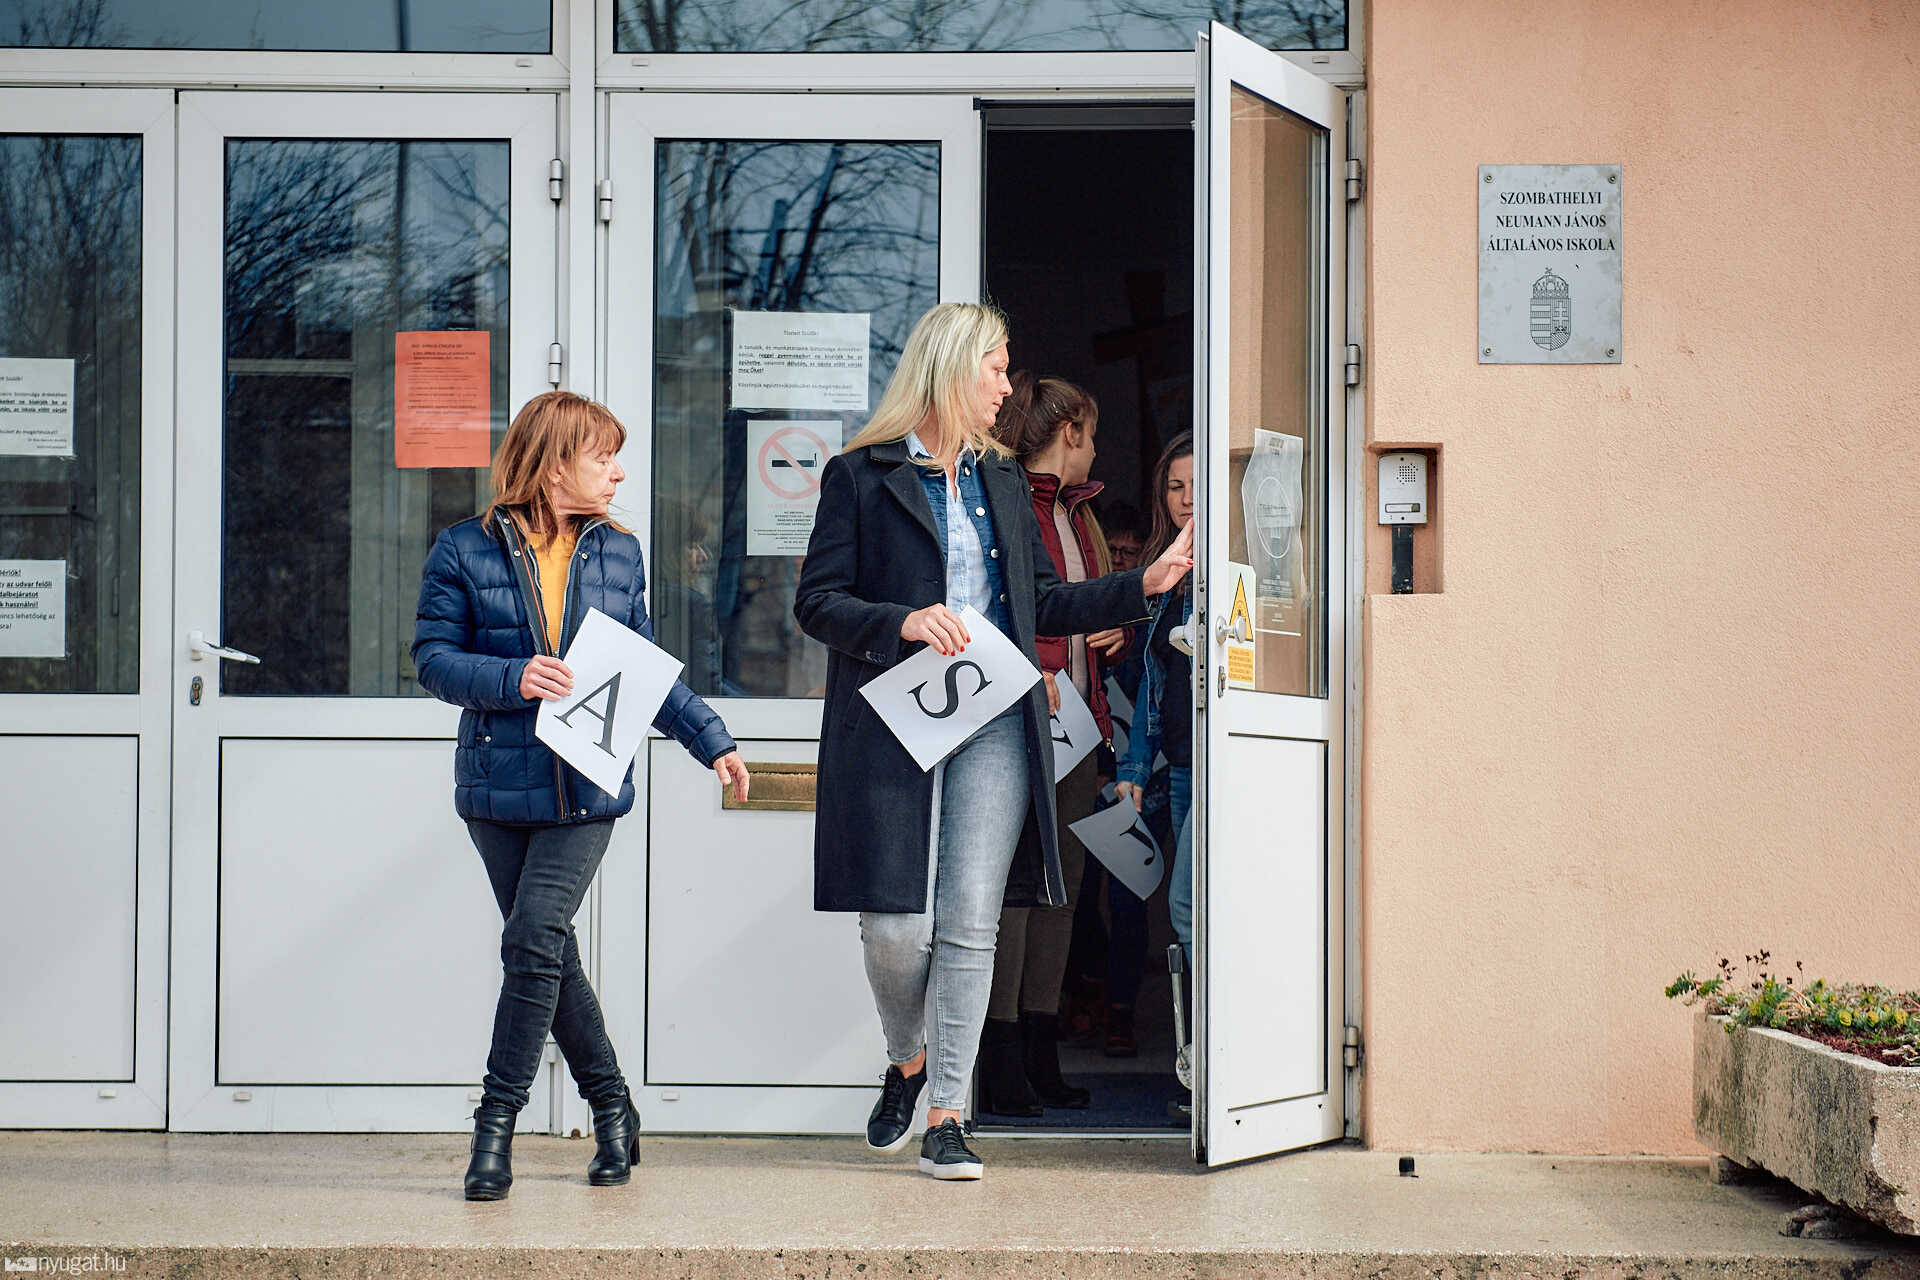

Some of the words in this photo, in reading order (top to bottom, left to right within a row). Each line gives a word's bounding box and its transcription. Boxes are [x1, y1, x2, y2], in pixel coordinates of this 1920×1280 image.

[1500, 191, 1601, 205] SZOMBATHELYI
[1496, 215, 1561, 228] NEUMANN
[1564, 211, 1607, 228] JÁNOS
[1487, 234, 1563, 251] ÁLTALÁNOS
[1567, 238, 1616, 251] ISKOLA
[907, 659, 993, 720] S
[554, 671, 617, 759] A
[1119, 817, 1157, 867] J
